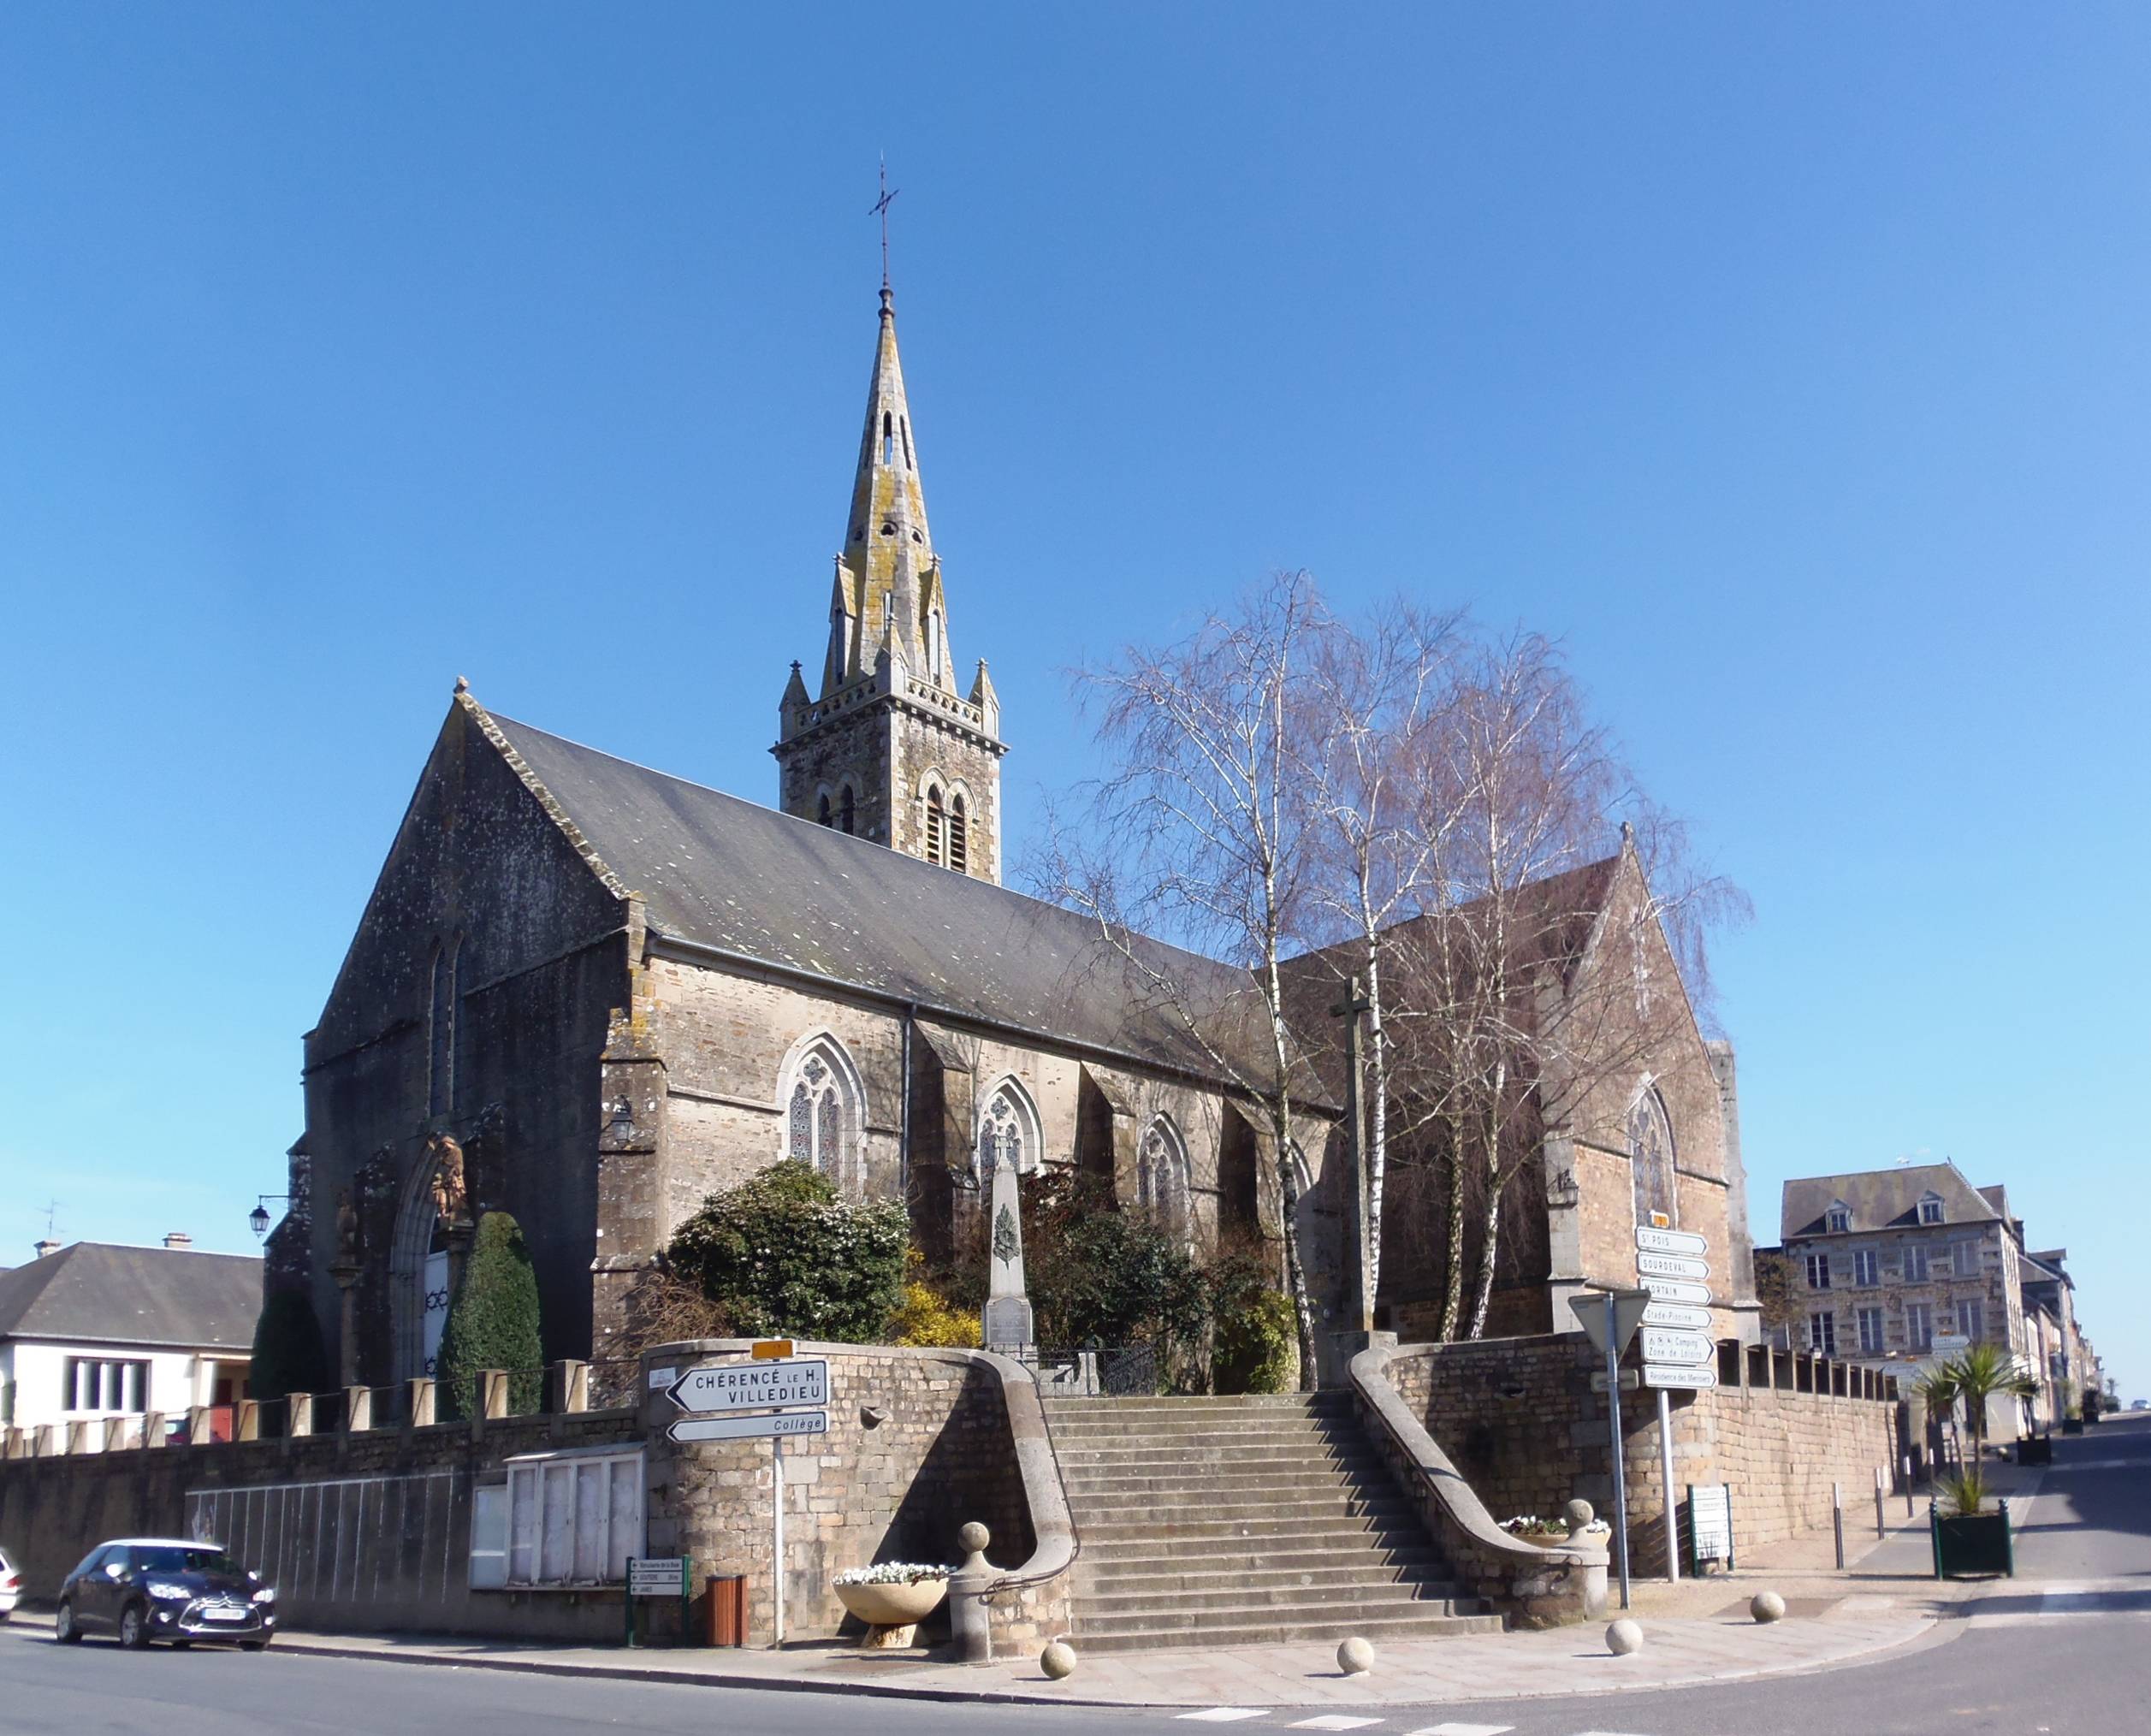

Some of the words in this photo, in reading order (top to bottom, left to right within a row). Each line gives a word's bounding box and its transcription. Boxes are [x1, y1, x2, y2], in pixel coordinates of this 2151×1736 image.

[1652, 1235, 1669, 1247] POIS
[1643, 1259, 1686, 1273] SOURDEVAL
[1675, 1336, 1698, 1349] Camping
[1648, 1347, 1665, 1358] Zone
[1669, 1348, 1677, 1359] de
[696, 1369, 780, 1389] CHÉRENCÉ
[786, 1373, 799, 1383] LE
[805, 1369, 821, 1383] H.
[728, 1386, 821, 1404] VILLEDIEU
[773, 1418, 821, 1431] Collège
